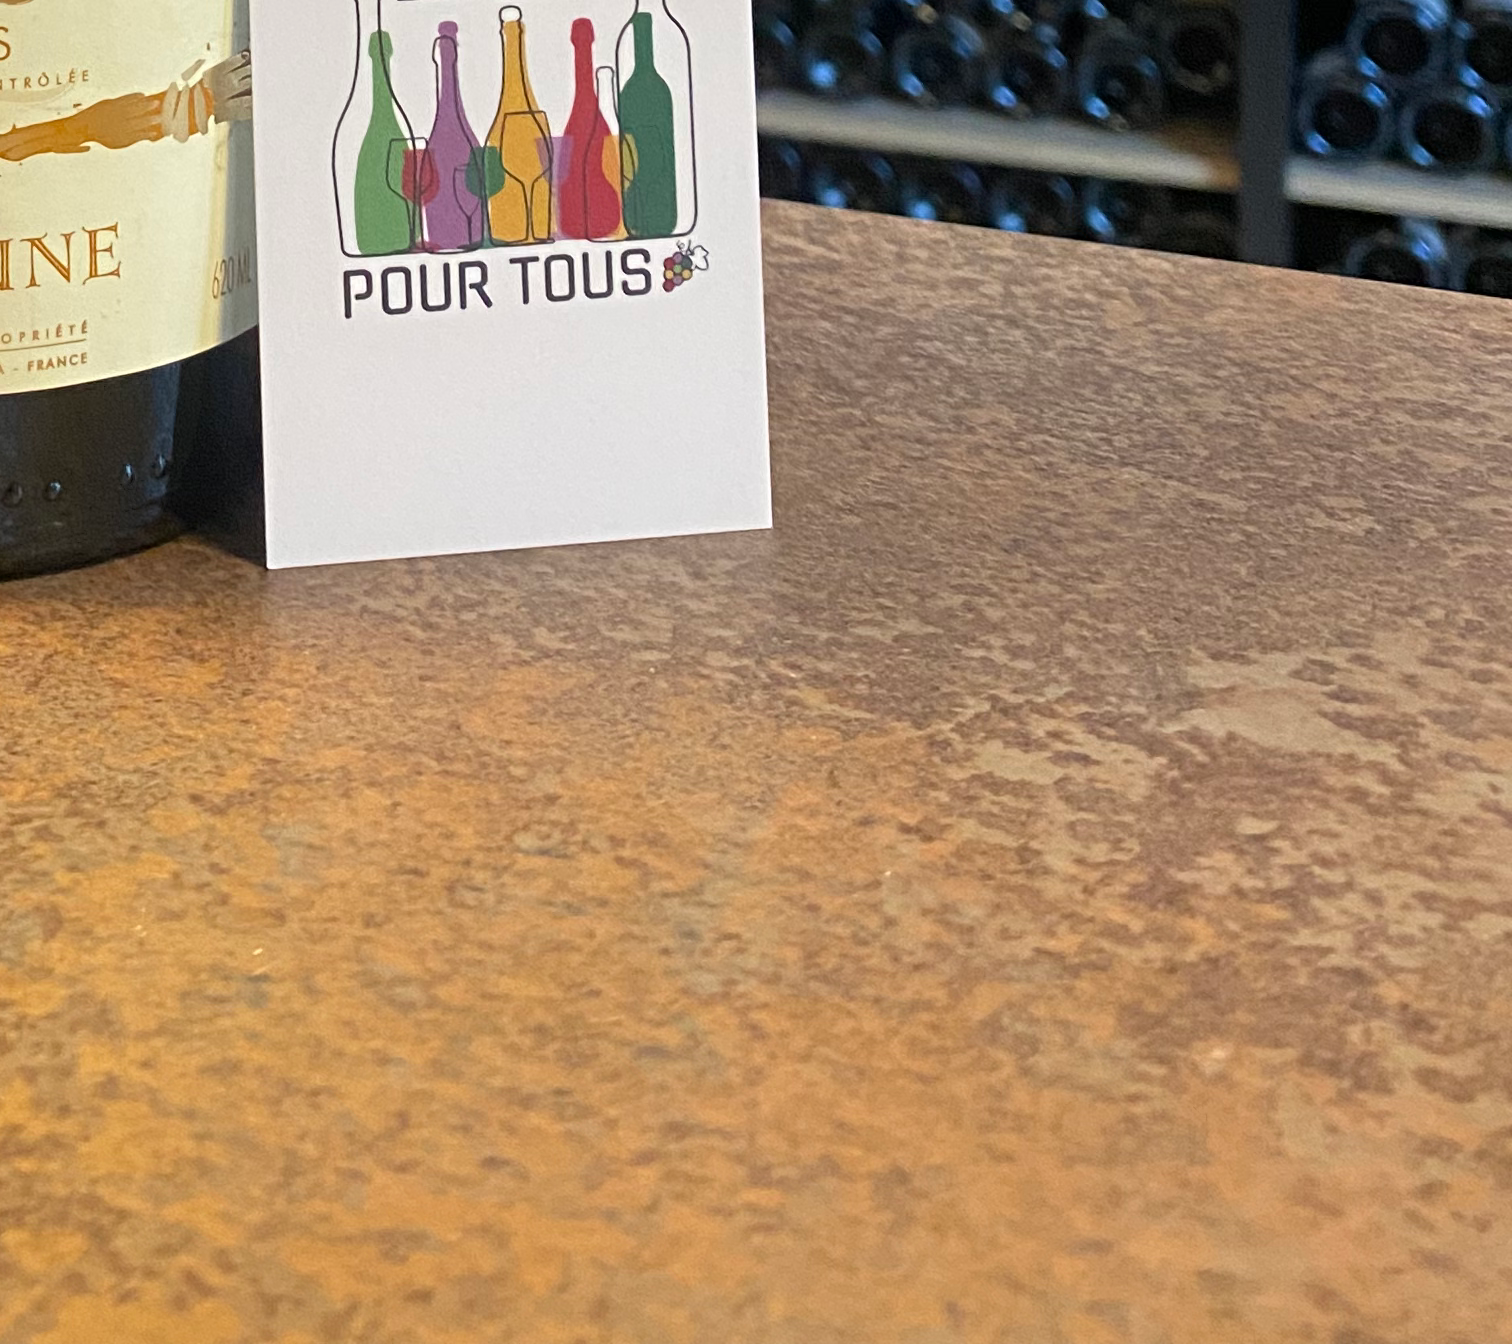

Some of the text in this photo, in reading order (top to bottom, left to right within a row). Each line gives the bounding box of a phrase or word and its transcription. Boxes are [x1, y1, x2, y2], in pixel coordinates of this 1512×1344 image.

[212, 256, 234, 299] 620
[342, 247, 653, 320] POUR TOUS
[27, 351, 88, 373] FRANCE
